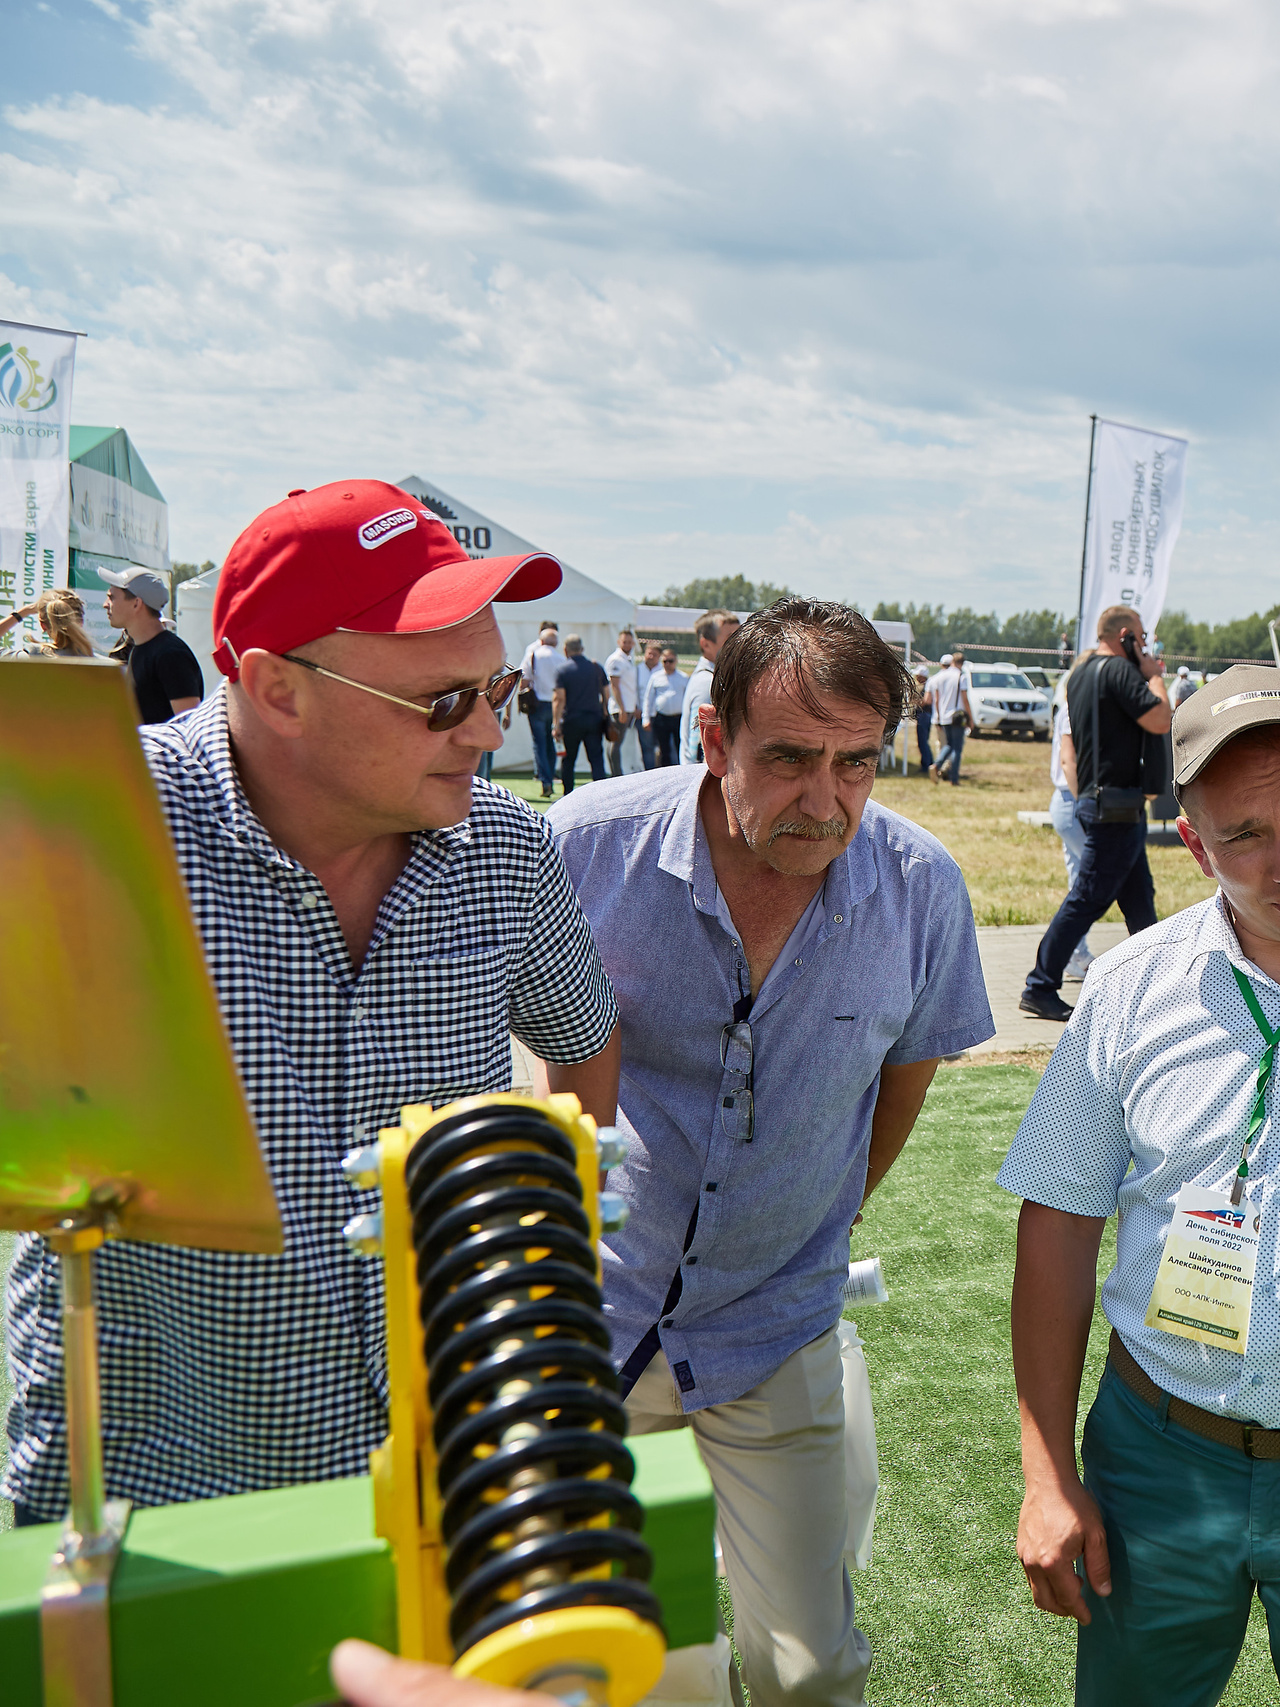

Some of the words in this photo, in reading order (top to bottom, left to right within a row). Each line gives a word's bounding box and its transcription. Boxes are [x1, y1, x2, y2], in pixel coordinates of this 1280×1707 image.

[27, 427, 61, 439] СОРТ
[25, 481, 39, 528] зерна
[1125, 459, 1146, 576] КОНВЕЙЕРНЫХ
[363, 511, 413, 540] MASCHIO
[1109, 520, 1125, 573] ЗАВОД
[23, 532, 36, 597] очистки
[42, 549, 55, 592] инии
[1185, 1219, 1208, 1232] День
[1210, 1227, 1258, 1246] сибирского
[1198, 1234, 1220, 1247] поля
[1221, 1240, 1242, 1252] 2022
[1167, 1255, 1213, 1275] Александр
[1188, 1251, 1242, 1273] Шайхудинов
[1174, 1288, 1191, 1298] ООО
[1159, 1311, 1182, 1321] Алтайский
[1221, 1329, 1233, 1337] 2022
